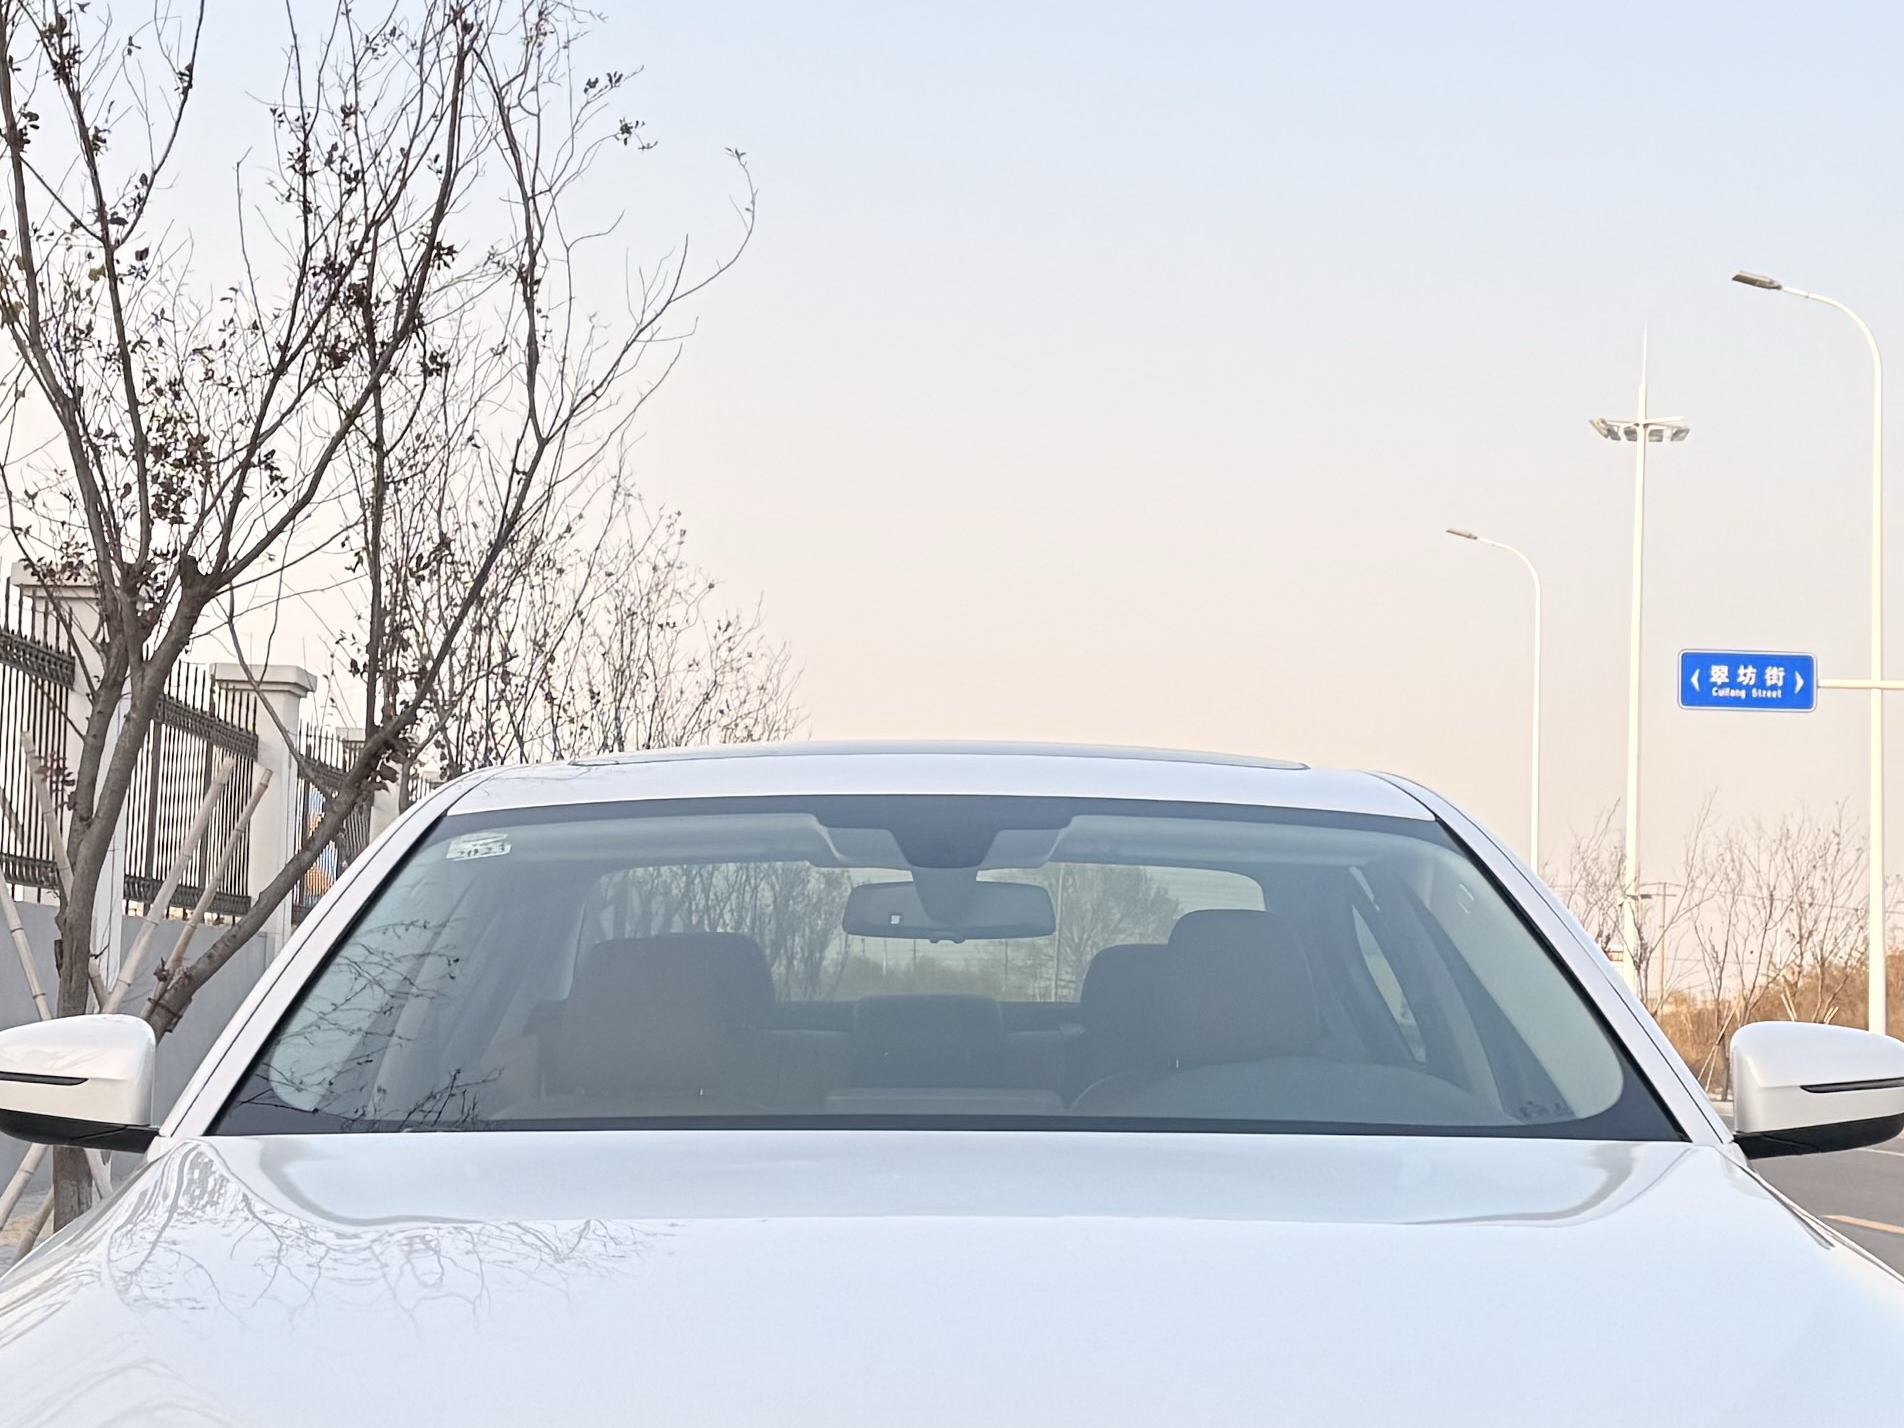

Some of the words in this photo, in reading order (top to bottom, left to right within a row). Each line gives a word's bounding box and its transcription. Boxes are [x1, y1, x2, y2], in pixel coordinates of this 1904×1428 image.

[1709, 665, 1786, 687] 翠坊街
[1712, 687, 1746, 699] Cuifang
[1751, 688, 1782, 698] Street
